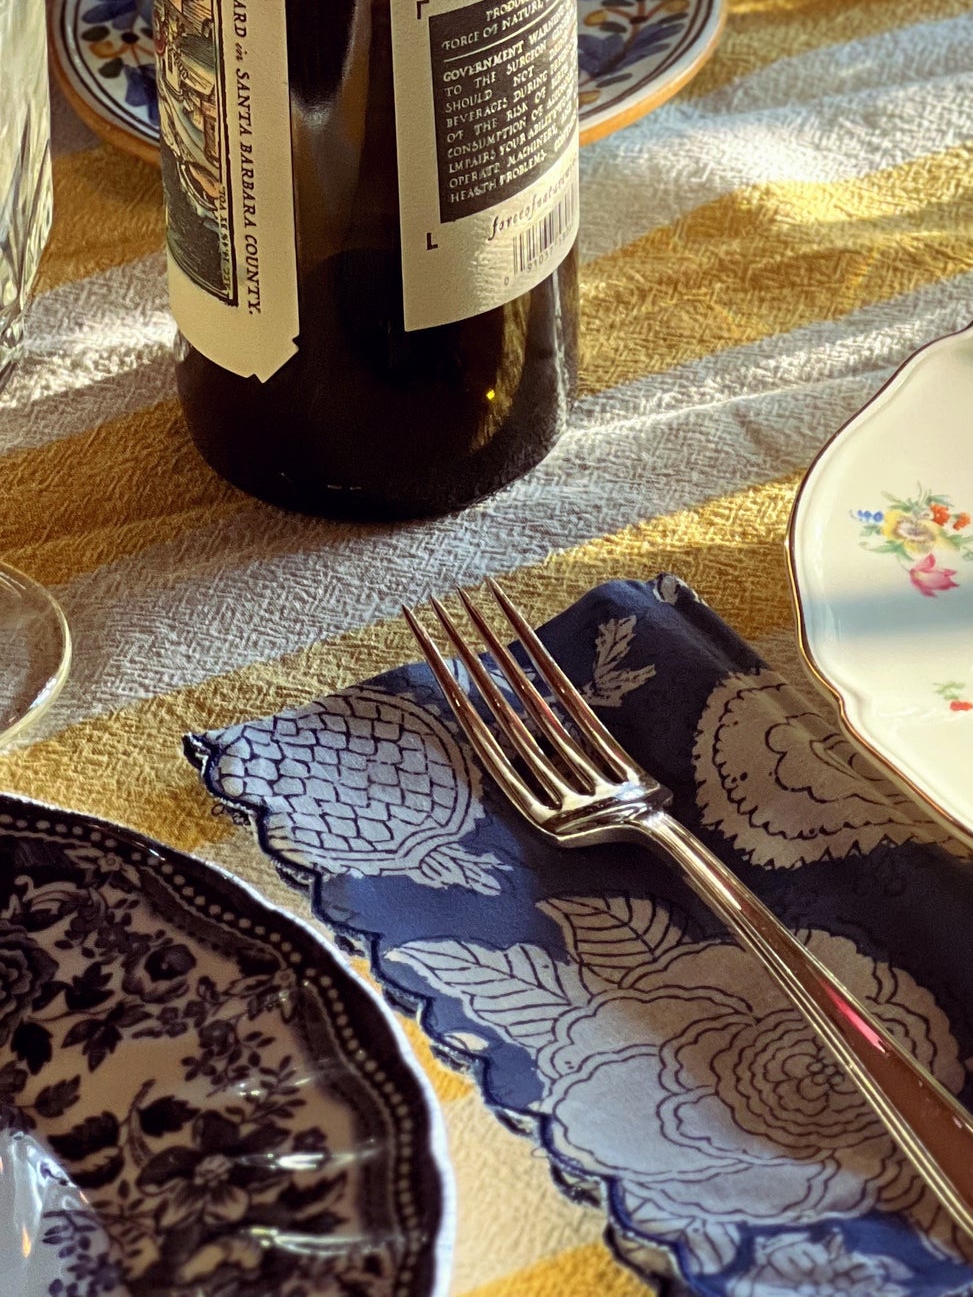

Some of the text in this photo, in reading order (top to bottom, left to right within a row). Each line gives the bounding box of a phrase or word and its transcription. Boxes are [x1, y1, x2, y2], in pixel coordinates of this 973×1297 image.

[235, 43, 248, 62] in
[442, 31, 480, 51] FORCE
[483, 24, 498, 39] OF
[443, 40, 525, 82] GOVERNMENT
[444, 84, 462, 97] TO
[473, 71, 497, 88] THE
[506, 39, 547, 75] SURGEON
[445, 89, 493, 113] SHOULD
[513, 65, 534, 87] NOT
[236, 68, 252, 136] SANTA
[446, 96, 508, 128] BEVERAGES
[513, 70, 548, 103] DURING
[446, 130, 464, 143] OF
[473, 117, 497, 136] THE
[506, 101, 528, 121] RISK
[534, 86, 546, 104] OF
[447, 116, 527, 158] CONSUMPTION
[531, 104, 544, 121] OF
[499, 132, 526, 156] YOUR
[527, 108, 557, 140] ABILITY
[240, 142, 257, 228] BARBARA
[245, 233, 261, 315] COUNTY.
